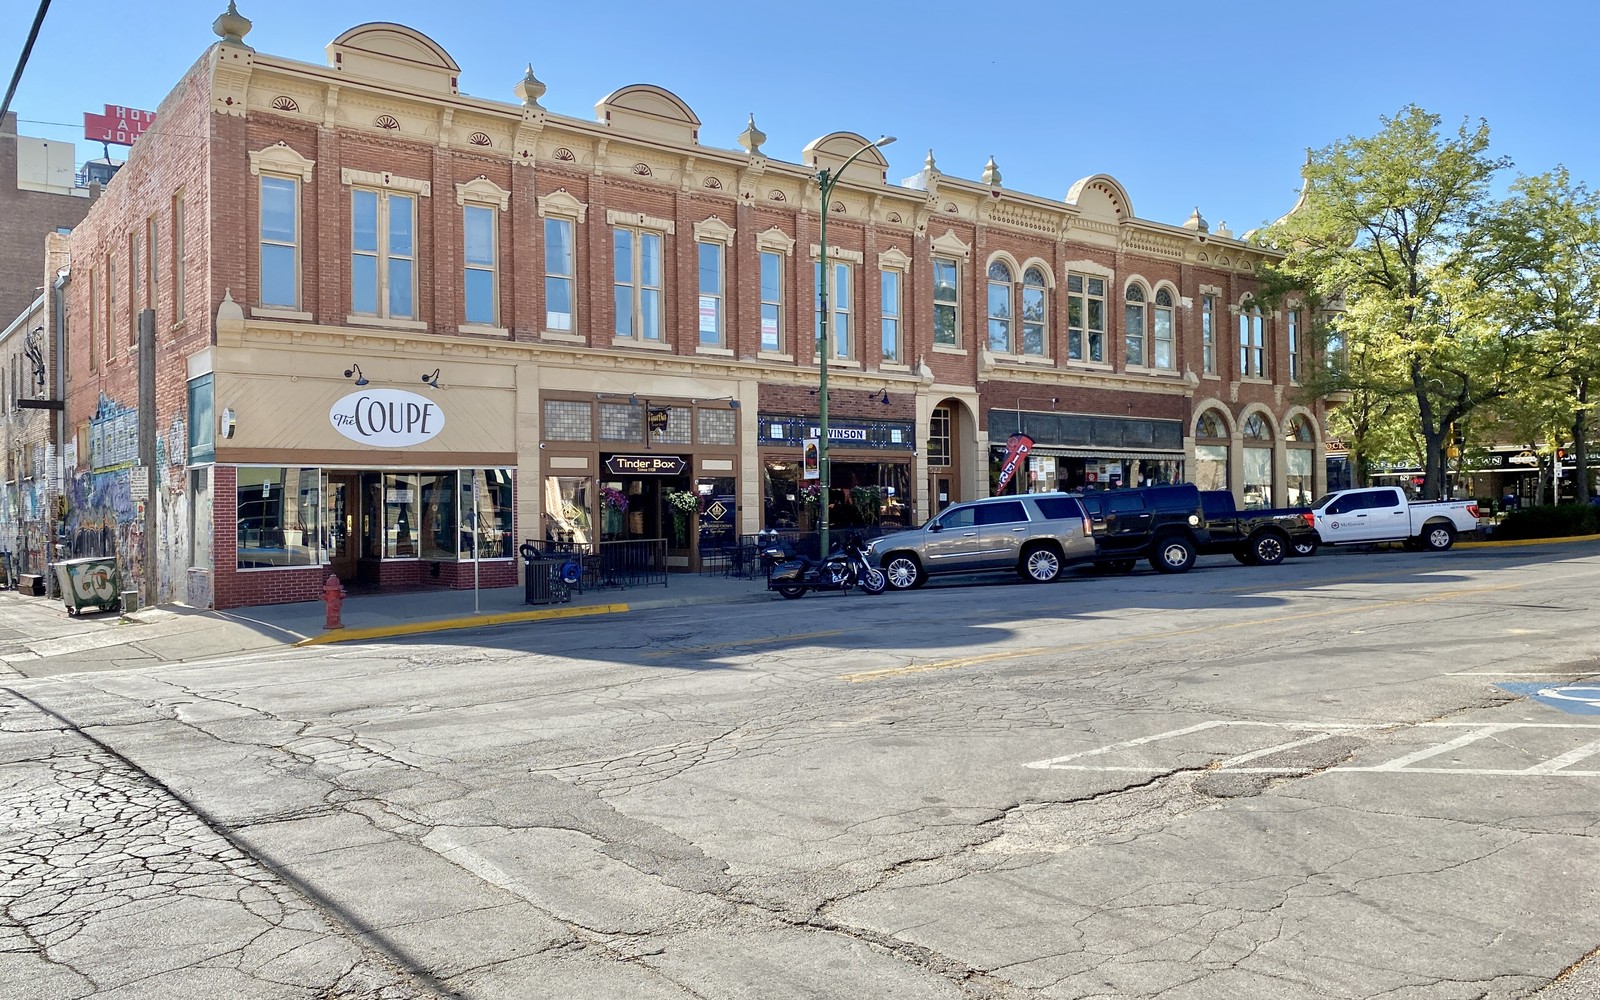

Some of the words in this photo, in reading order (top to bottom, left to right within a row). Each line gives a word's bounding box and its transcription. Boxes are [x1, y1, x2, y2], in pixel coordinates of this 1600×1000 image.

[116, 106, 152, 122] HOT
[334, 413, 356, 427] The
[354, 396, 434, 436] COUPE
[814, 428, 863, 438] LVINSON
[616, 458, 650, 468] Tinder
[653, 459, 676, 468] Box
[1466, 456, 1502, 466] PWN
